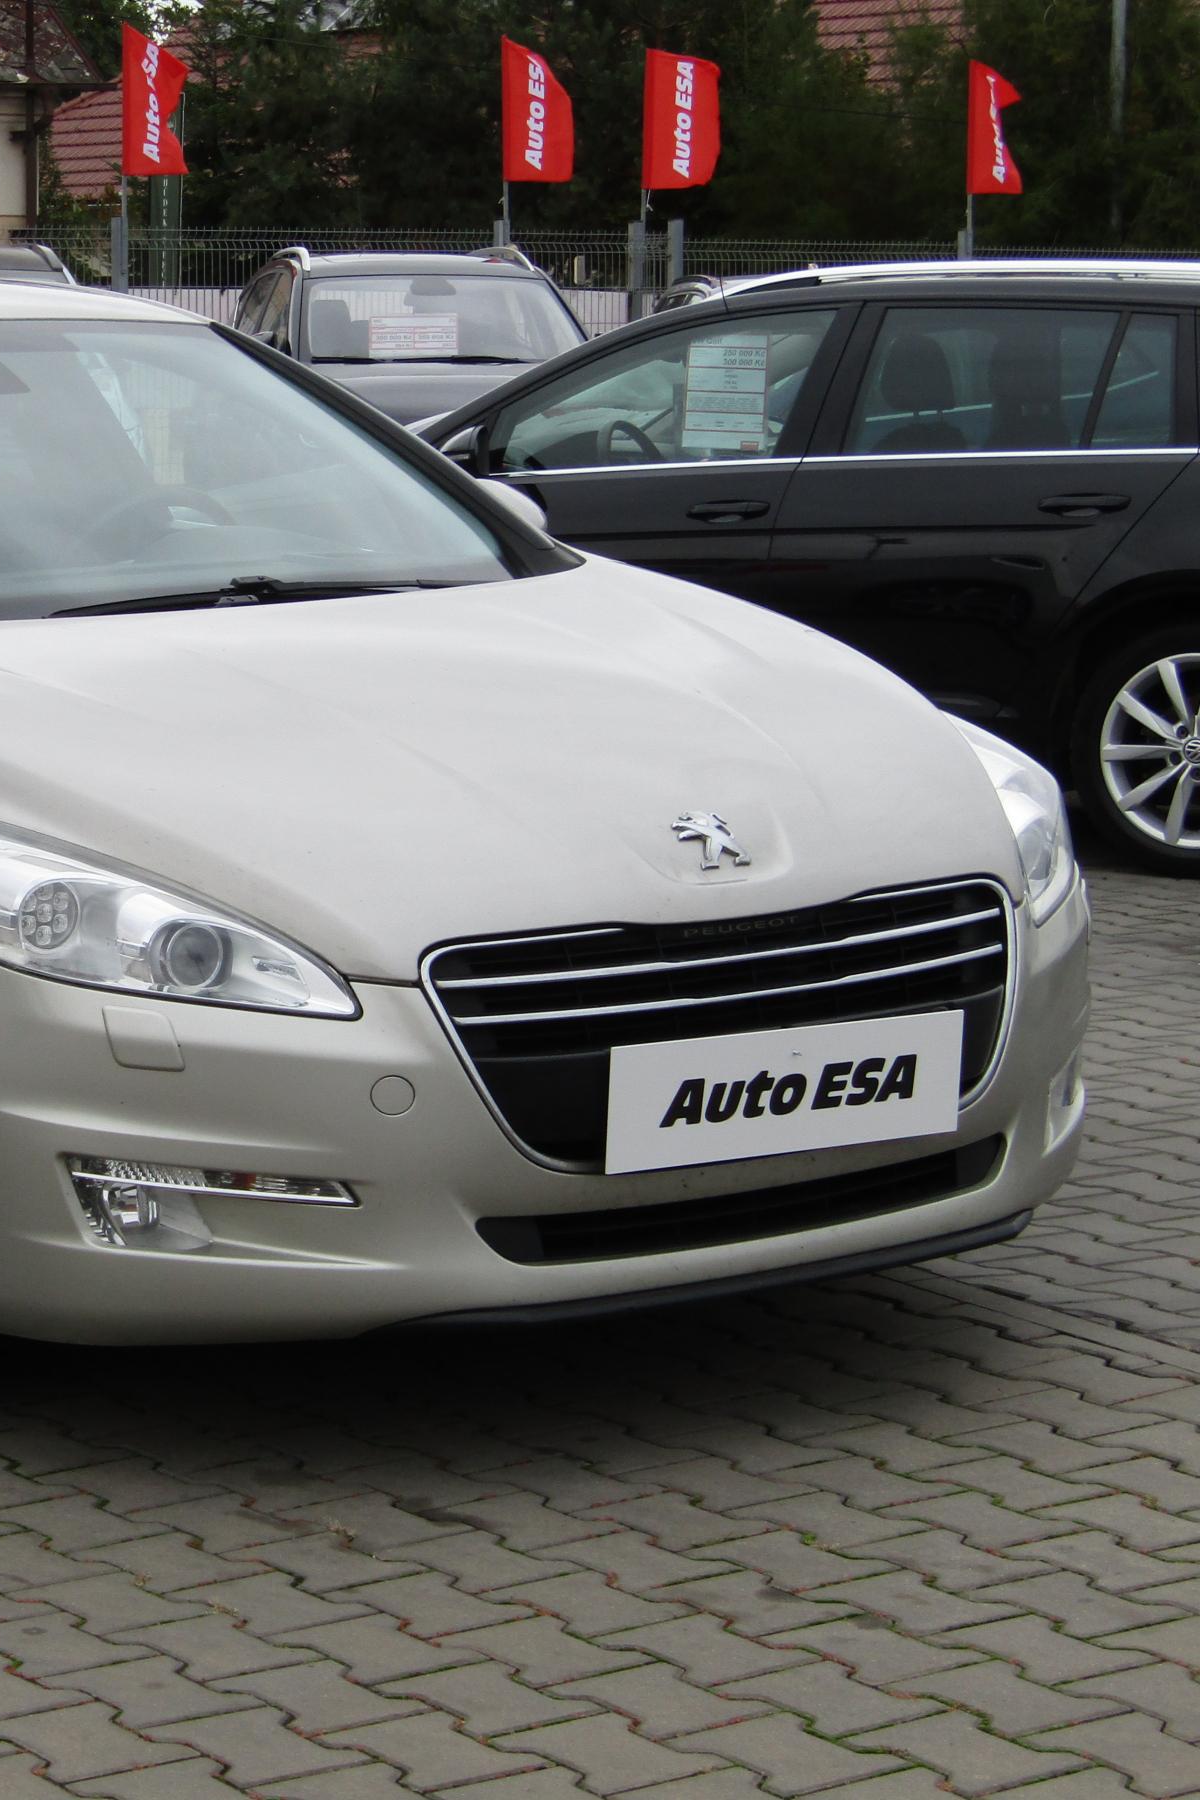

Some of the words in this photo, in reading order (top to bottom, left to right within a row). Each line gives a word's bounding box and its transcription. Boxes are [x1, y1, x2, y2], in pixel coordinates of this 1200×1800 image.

[674, 61, 694, 111] ESA
[142, 92, 160, 163] Auto
[525, 100, 545, 171] Auto
[672, 112, 692, 179] Auto
[683, 915, 799, 938] PEUGEOT
[659, 1070, 807, 1128] Auto
[811, 1054, 917, 1110] ESA
